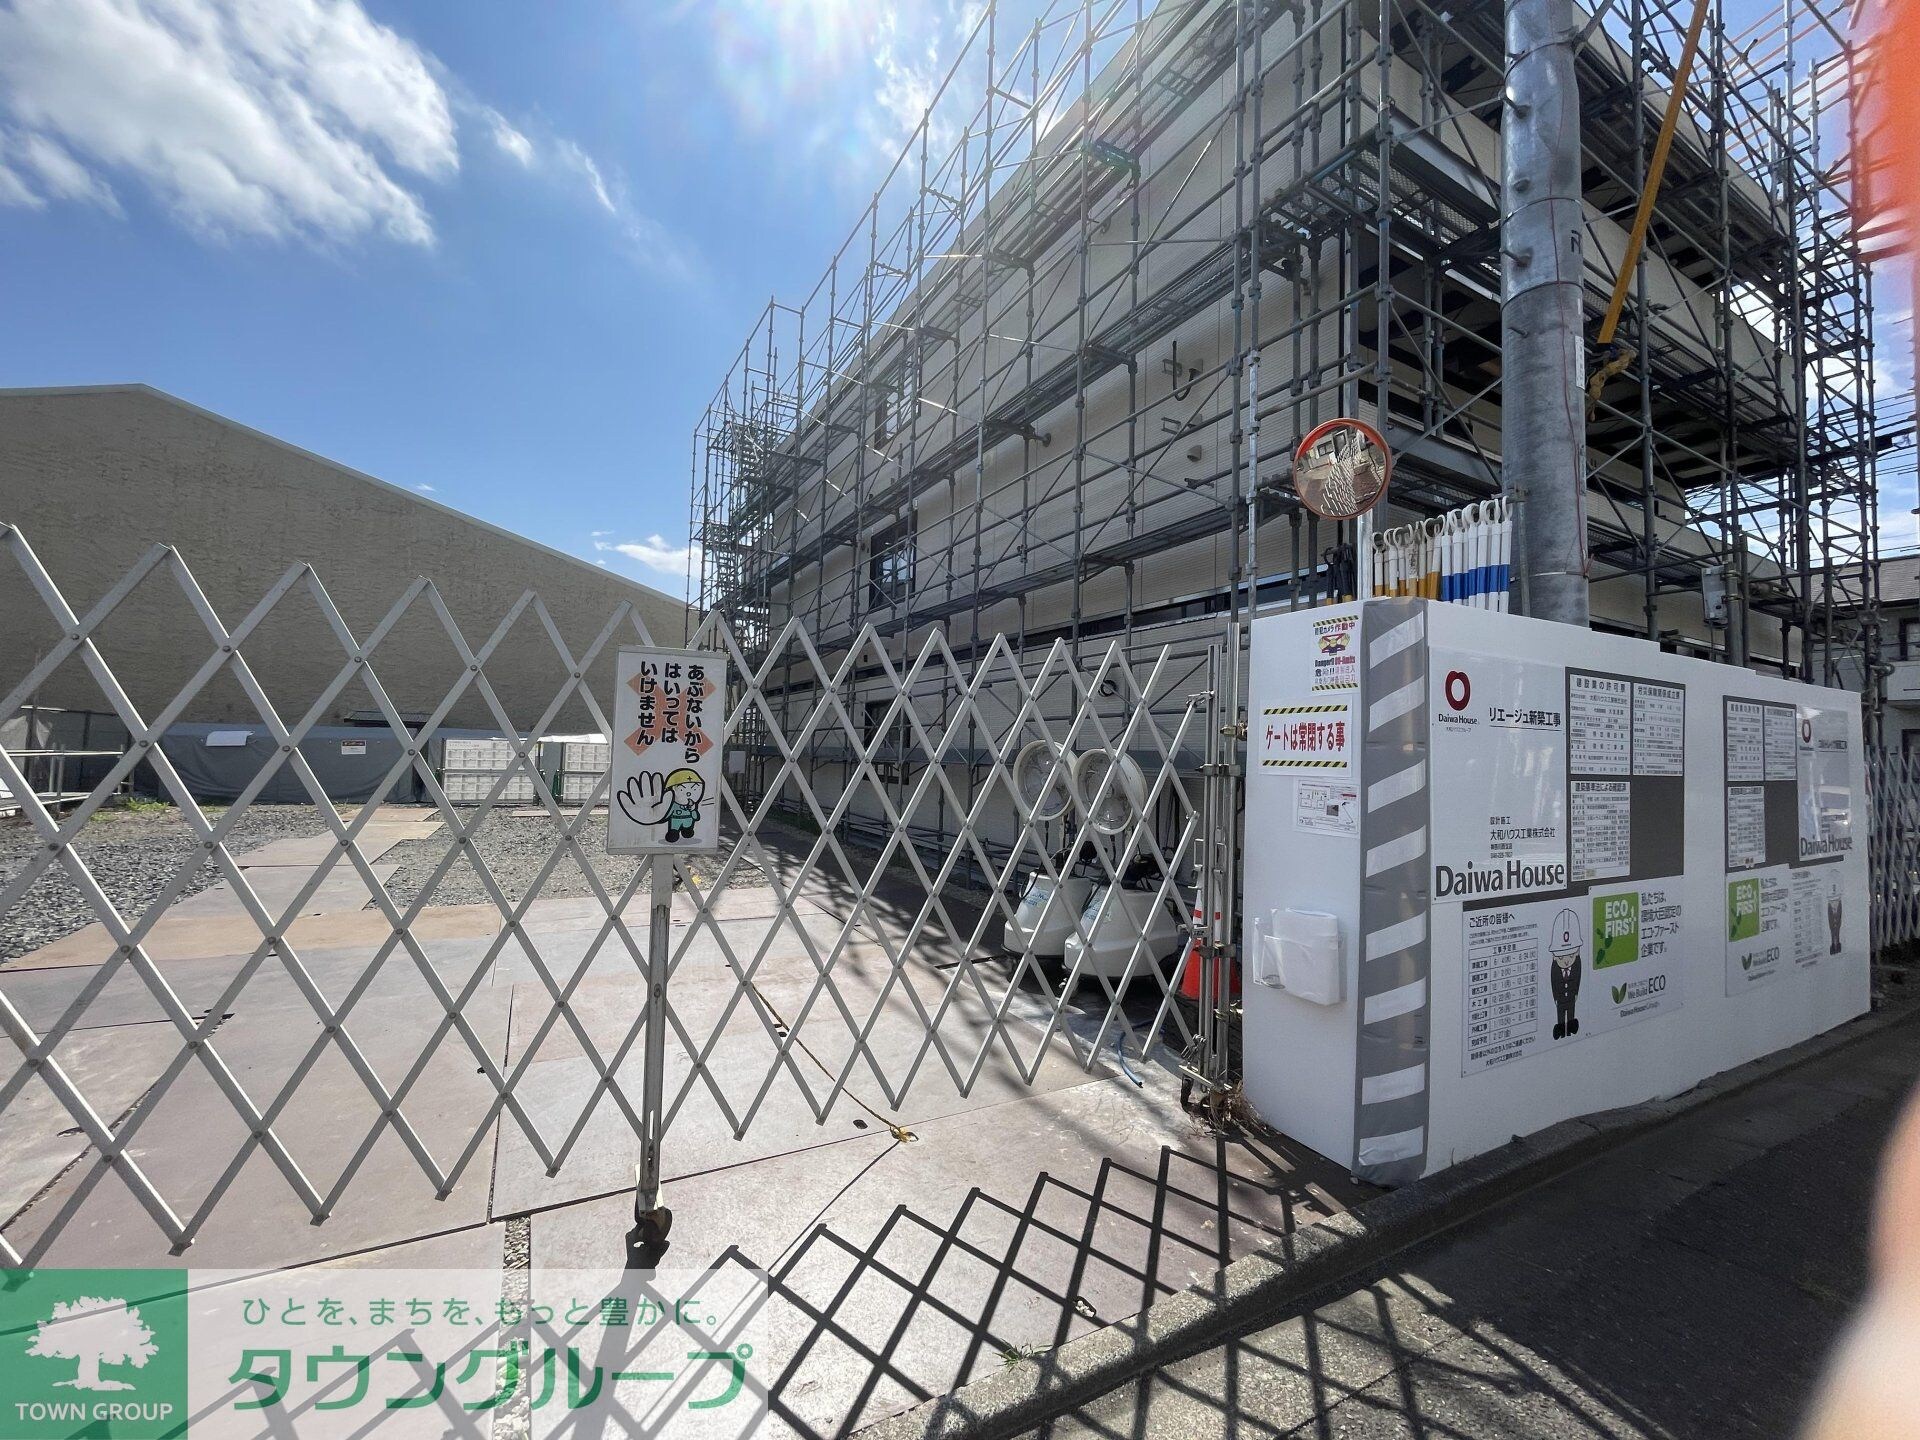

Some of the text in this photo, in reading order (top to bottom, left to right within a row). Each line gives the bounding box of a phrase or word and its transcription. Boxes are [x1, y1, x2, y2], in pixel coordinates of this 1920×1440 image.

[637, 660, 658, 746] いけません
[661, 662, 682, 744] はいっては
[684, 664, 705, 764] あぶないから
[1438, 713, 1478, 725] Daiwa House
[1489, 707, 1561, 727] リエージュ新築工事
[1266, 721, 1346, 752] ゲートは常閉する事
[1490, 827, 1556, 841] 大和ハウス工業株式会社
[1800, 834, 1853, 856] Daiwa House
[1436, 860, 1565, 897] Daiwa House
[1736, 884, 1753, 901] ECO
[1469, 912, 1516, 928] ご近所の皆様へ
[1605, 900, 1629, 919] ECO
[1605, 914, 1637, 938] FIRST
[1648, 974, 1666, 995] ECO
